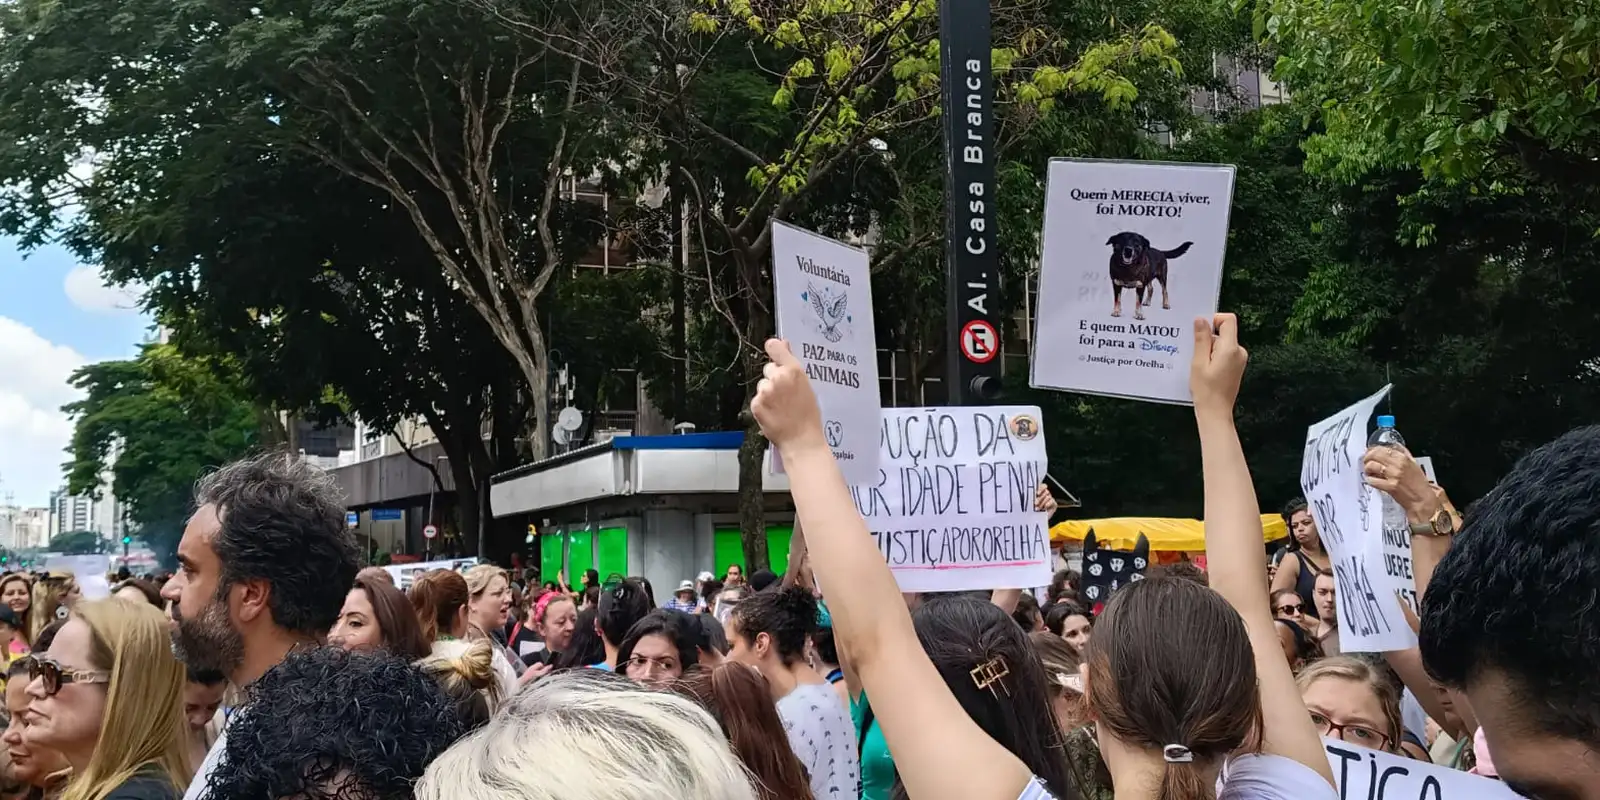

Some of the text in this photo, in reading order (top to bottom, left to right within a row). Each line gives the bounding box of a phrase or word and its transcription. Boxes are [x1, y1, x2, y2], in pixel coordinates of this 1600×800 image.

[963, 58, 988, 315] Al. Casa Branca
[1070, 188, 1210, 205] Quem MERECIA viver,
[1096, 203, 1182, 218] foi MORTO!
[796, 255, 850, 287] Voluntária
[1079, 319, 1180, 338] E quem MATOU
[1079, 334, 1095, 346] foi
[1098, 338, 1125, 349] para
[1128, 340, 1135, 349] a
[803, 342, 857, 366] PAZ PARA OS
[1086, 354, 1164, 369] Justiça por Orelha
[806, 362, 860, 389] ANIMAIS
[881, 408, 1015, 467] UÇÃO DA
[900, 464, 968, 516] IDADE
